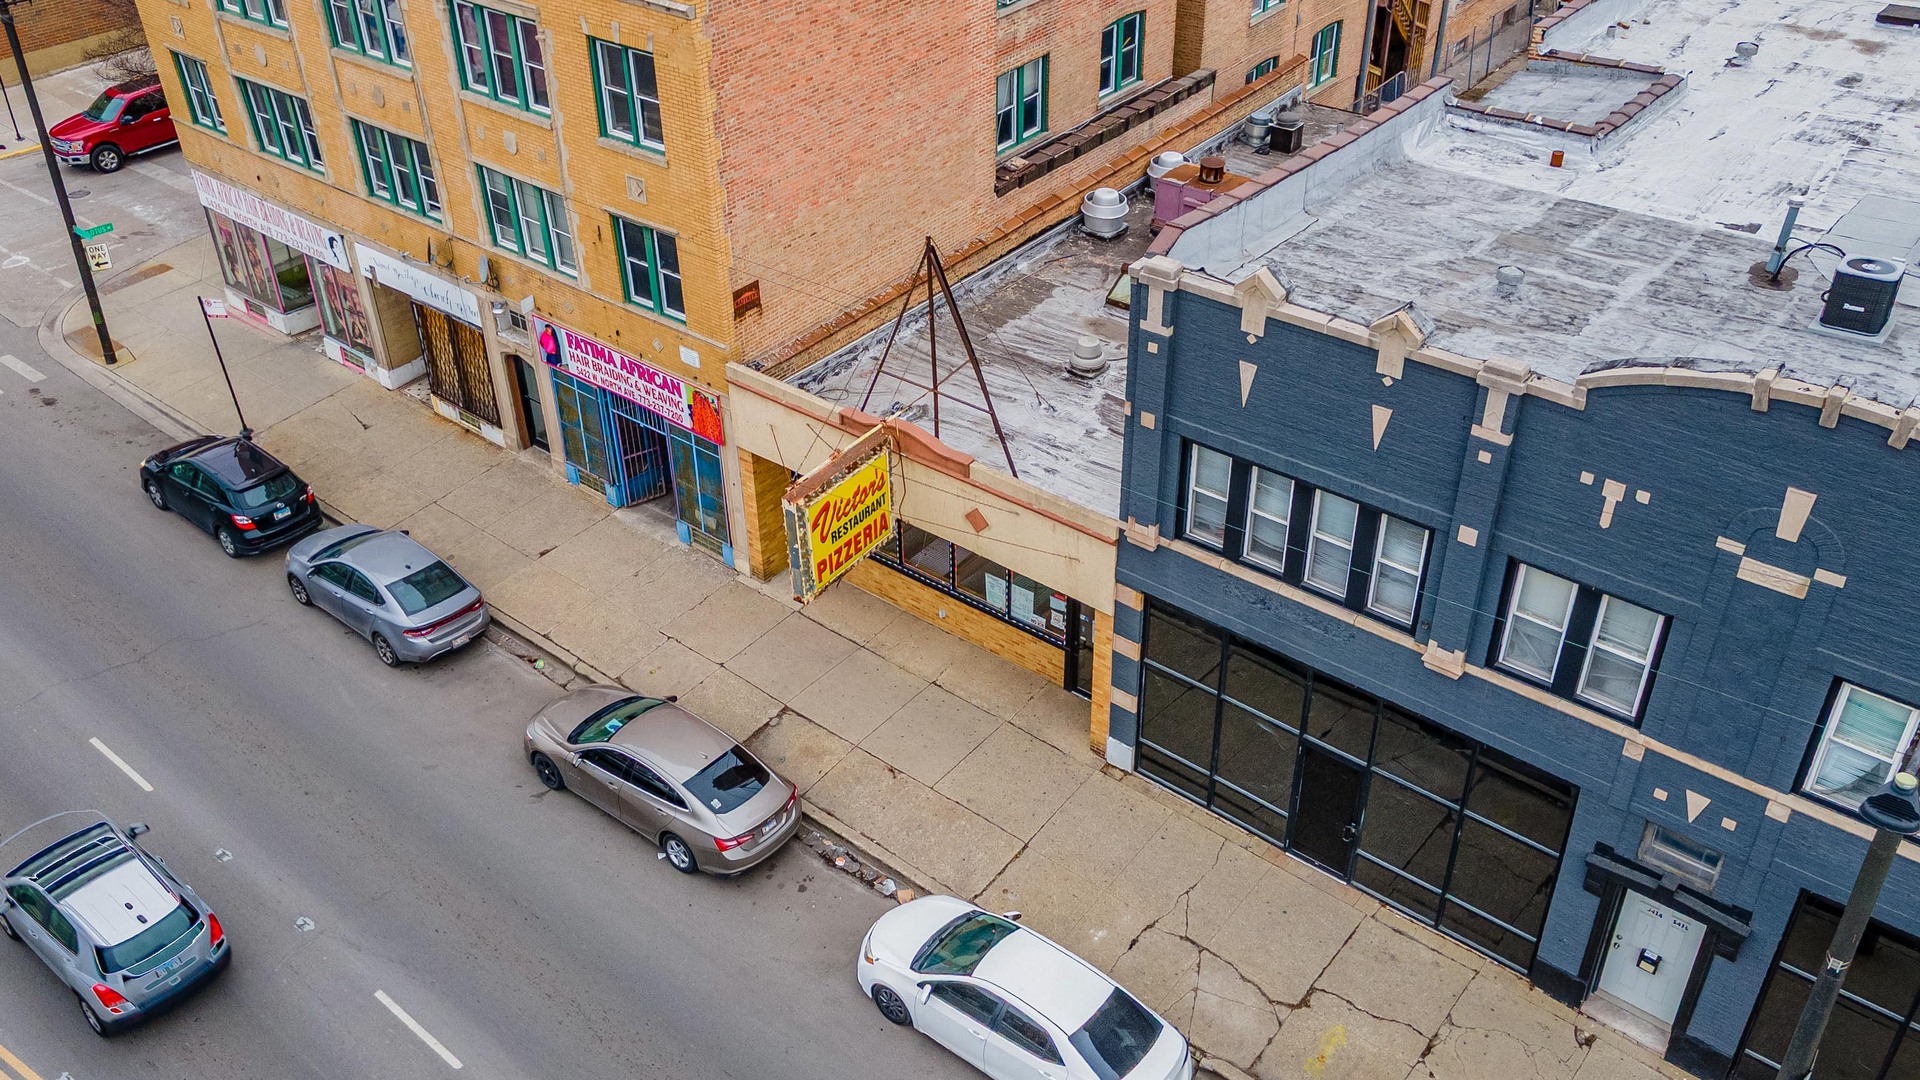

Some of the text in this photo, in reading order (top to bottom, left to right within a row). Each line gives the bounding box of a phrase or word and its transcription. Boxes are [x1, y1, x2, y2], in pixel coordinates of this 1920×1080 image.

[88, 225, 106, 235] OTUS
[214, 181, 245, 212] AFRICAN
[294, 217, 327, 249] WEAVING
[233, 210, 258, 229] NORTH
[89, 245, 106, 253] ONE
[90, 252, 107, 260] WAY
[565, 332, 618, 369] FATIMA
[620, 355, 683, 399] AFRICAN
[569, 350, 685, 412] HAIR BRAIDING & WEAVING
[576, 366, 591, 379] 5422
[601, 378, 622, 394] NORTH
[638, 394, 684, 423] 773-237-7200
[811, 468, 886, 544] Victor's
[830, 492, 887, 544] RESTAURANT
[816, 511, 889, 584] PIZZERIA
